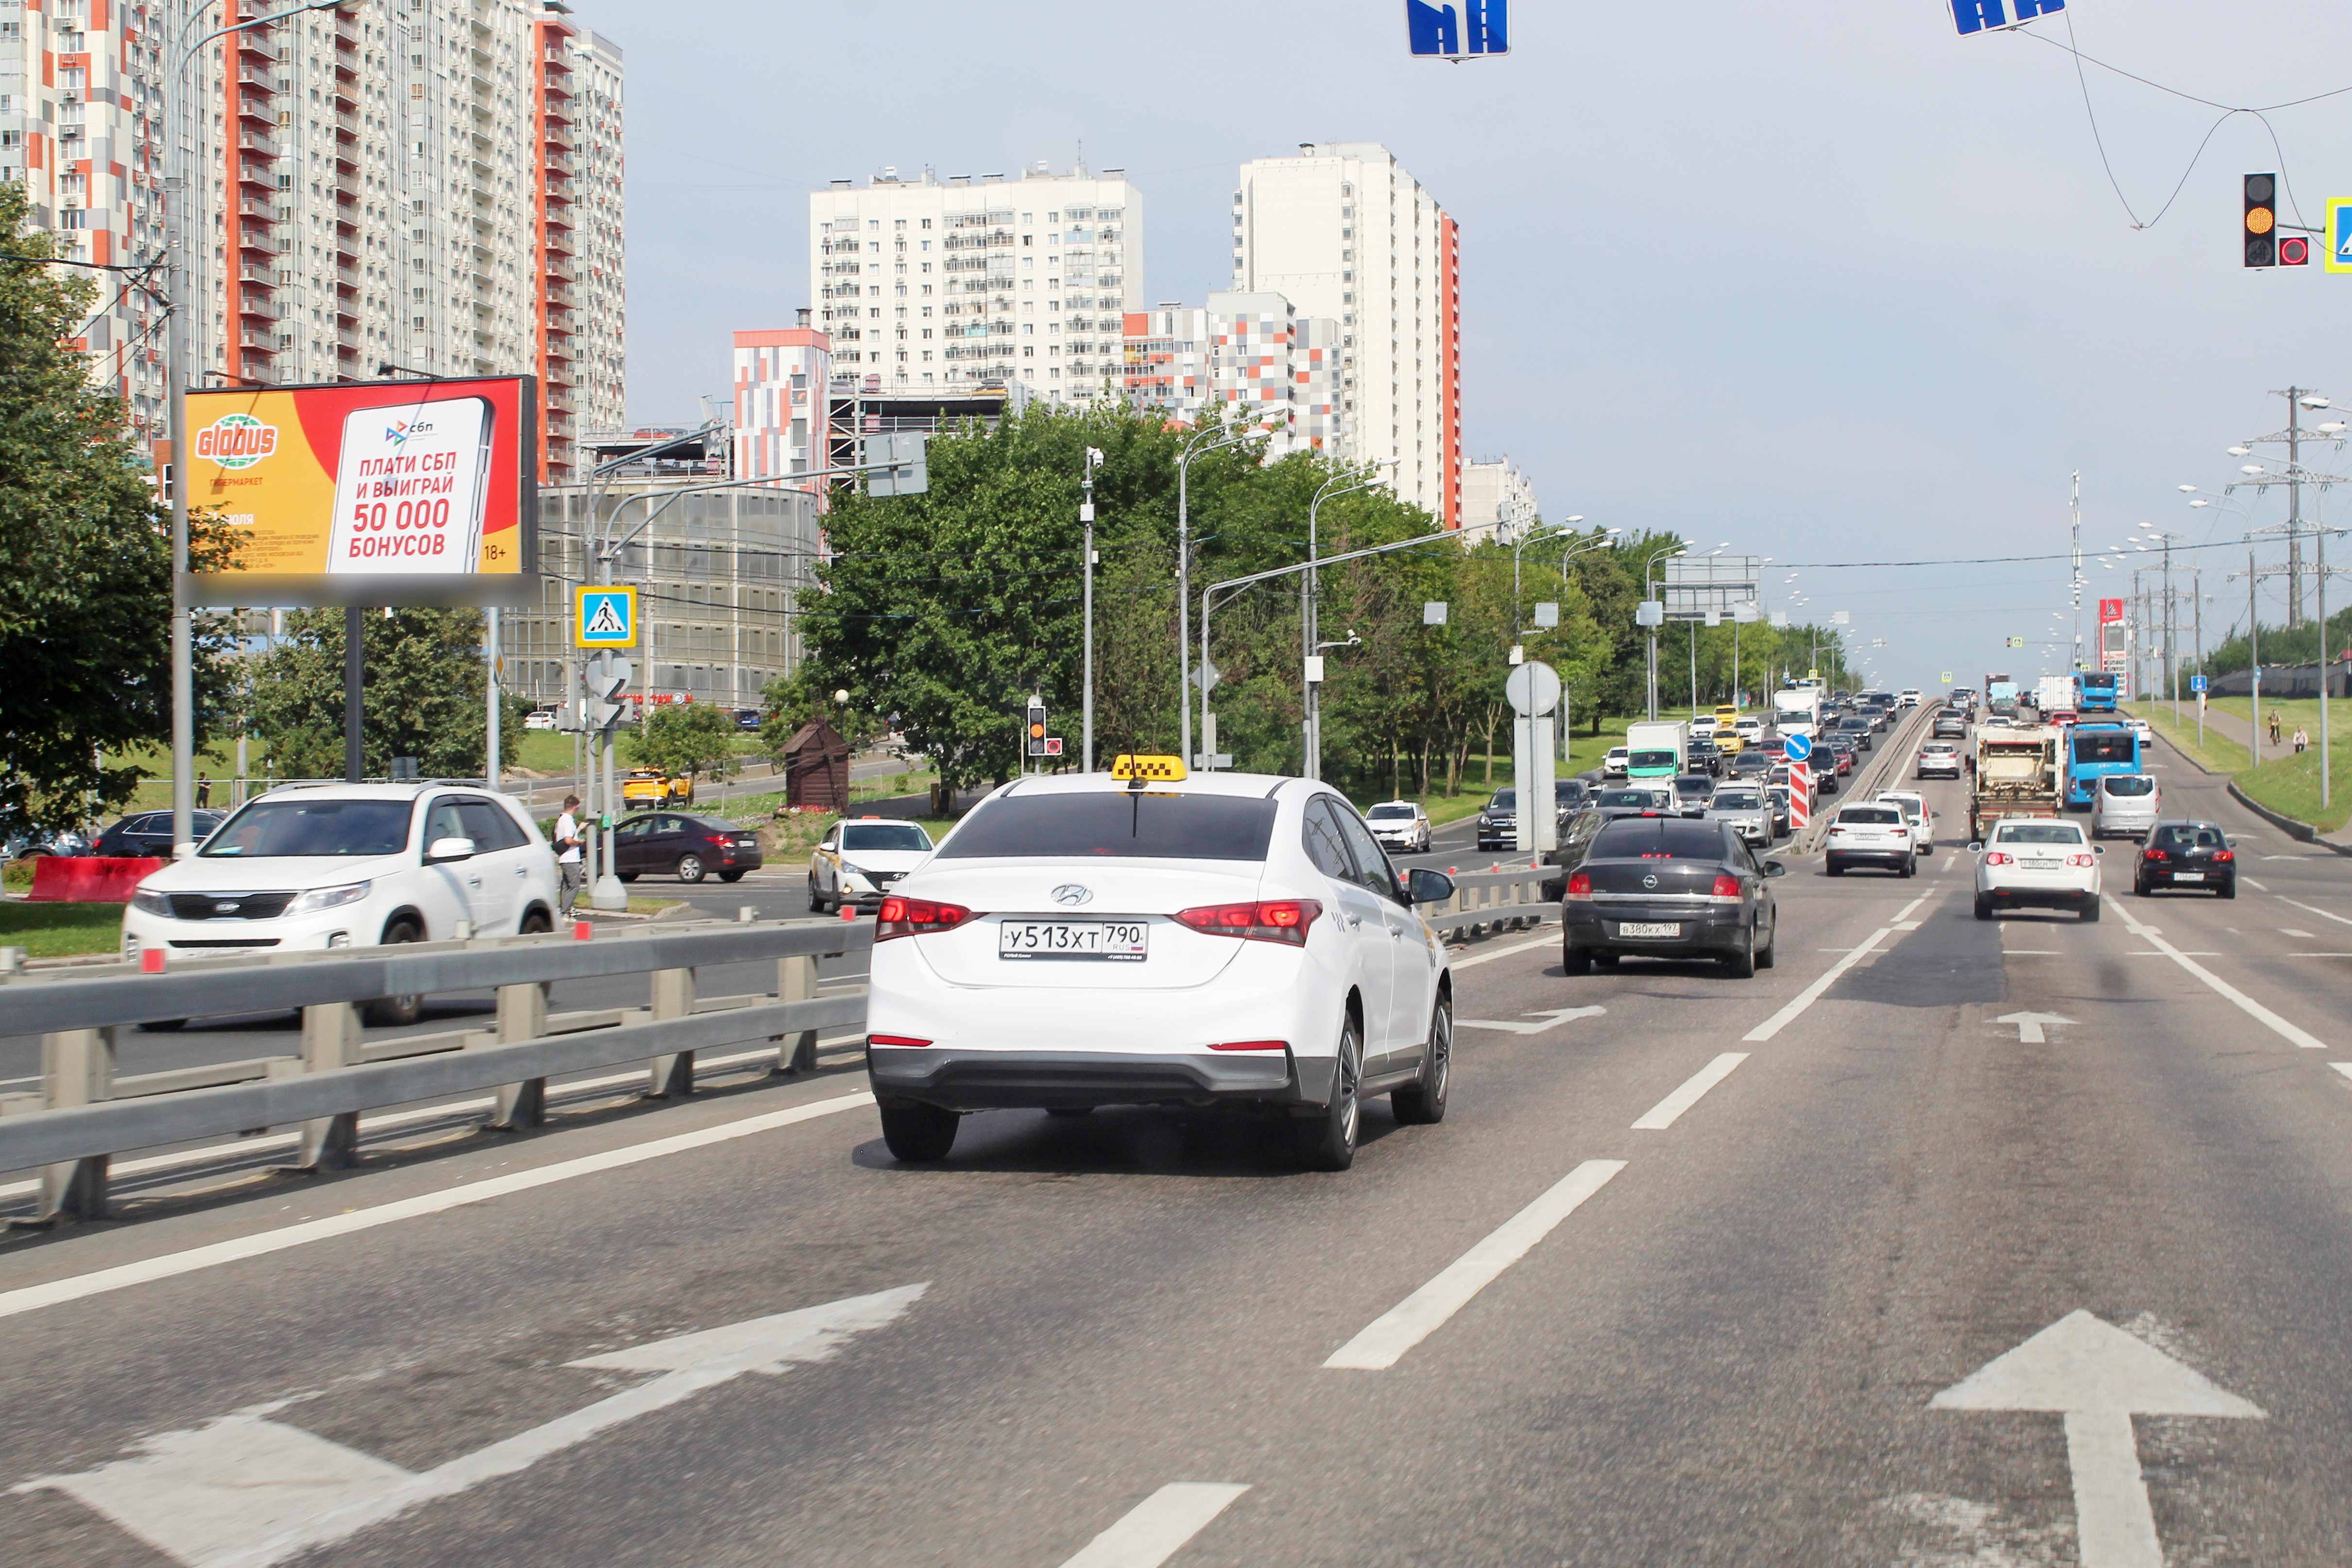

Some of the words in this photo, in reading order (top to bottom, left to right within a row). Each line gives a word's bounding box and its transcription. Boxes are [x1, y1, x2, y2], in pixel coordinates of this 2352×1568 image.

[410, 422, 433, 432] сбп
[359, 456, 417, 477] ПЛАТИ
[422, 451, 457, 471] СБП
[357, 482, 367, 499] И
[373, 472, 453, 498] ВЫИГРАЙ
[353, 502, 387, 532] 50
[396, 498, 449, 529] 000
[349, 534, 445, 558] БОНУСОВ
[485, 545, 506, 560] 18+
[1106, 926, 1140, 943] 790
